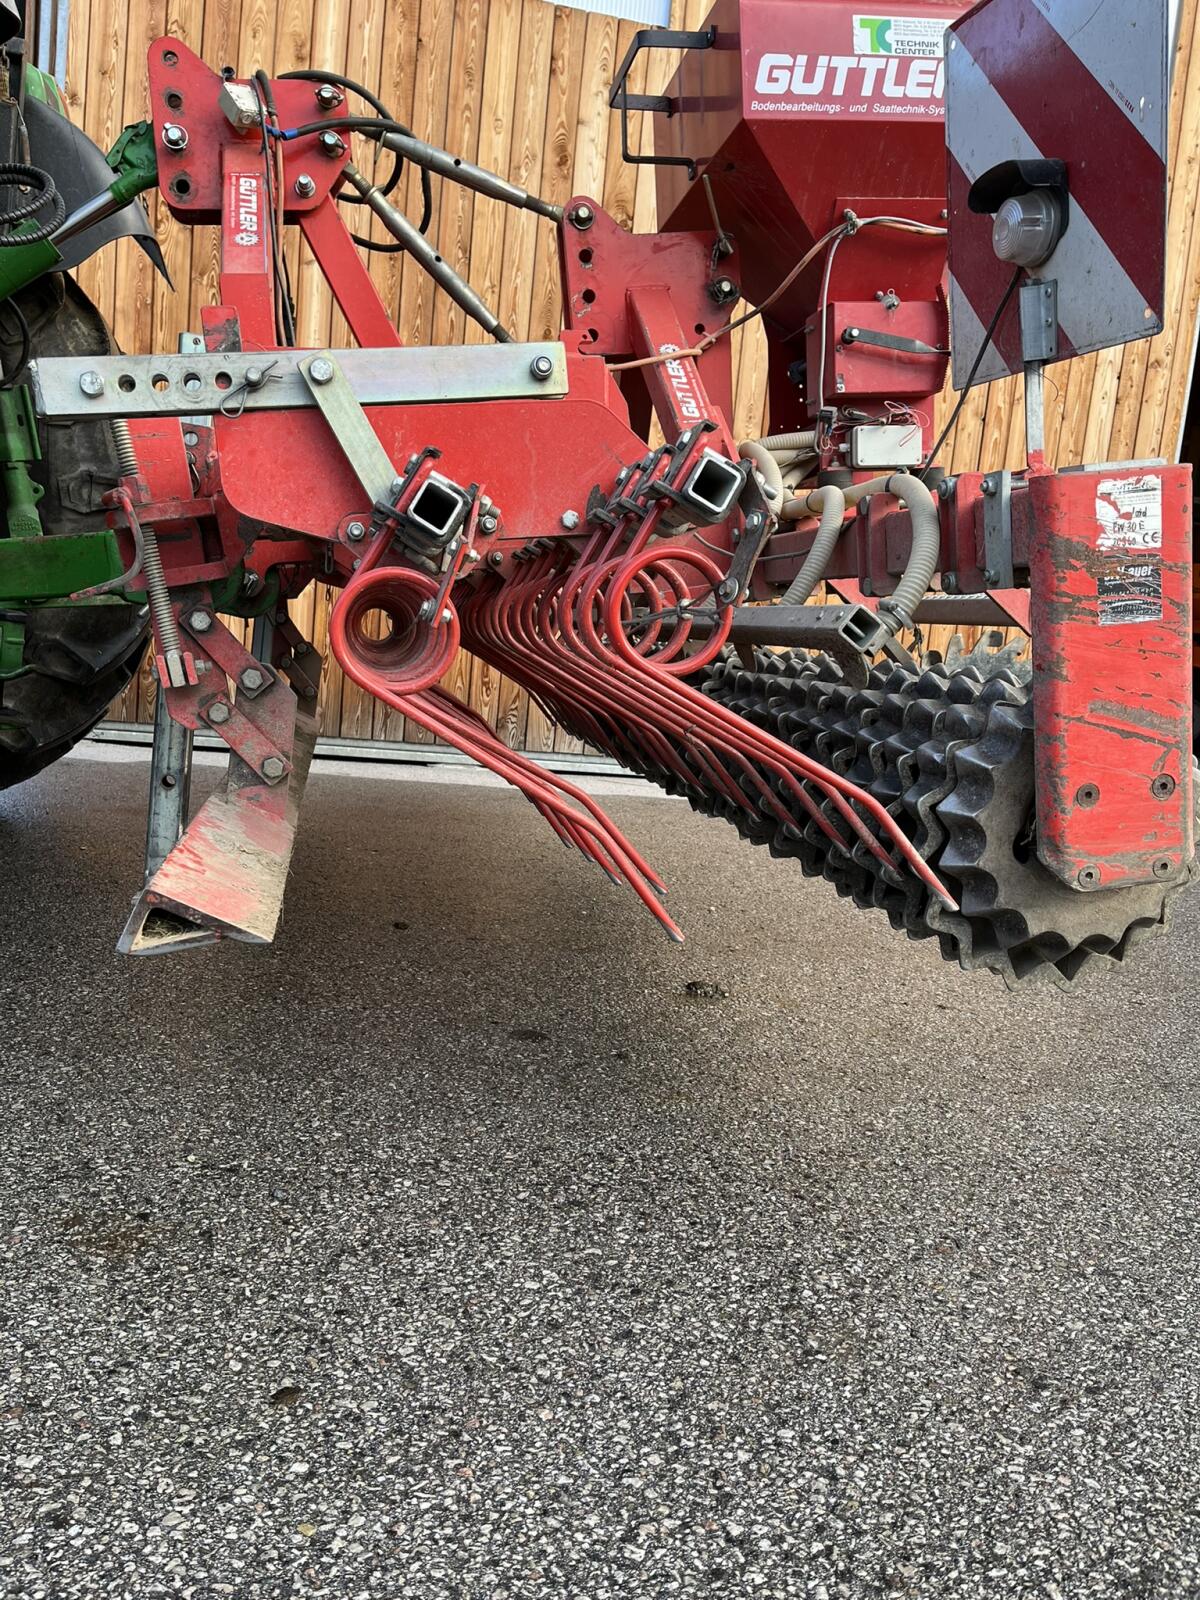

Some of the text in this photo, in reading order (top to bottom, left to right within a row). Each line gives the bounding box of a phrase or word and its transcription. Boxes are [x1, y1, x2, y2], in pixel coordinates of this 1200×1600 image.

[894, 39, 940, 48] TECHNIK
[894, 47, 936, 56] CENTER
[751, 101, 845, 113] Bodenbearbeitungs-
[849, 103, 867, 112] und
[239, 177, 258, 232] GÜTTLER
[664, 359, 701, 418] GÜTTLER
